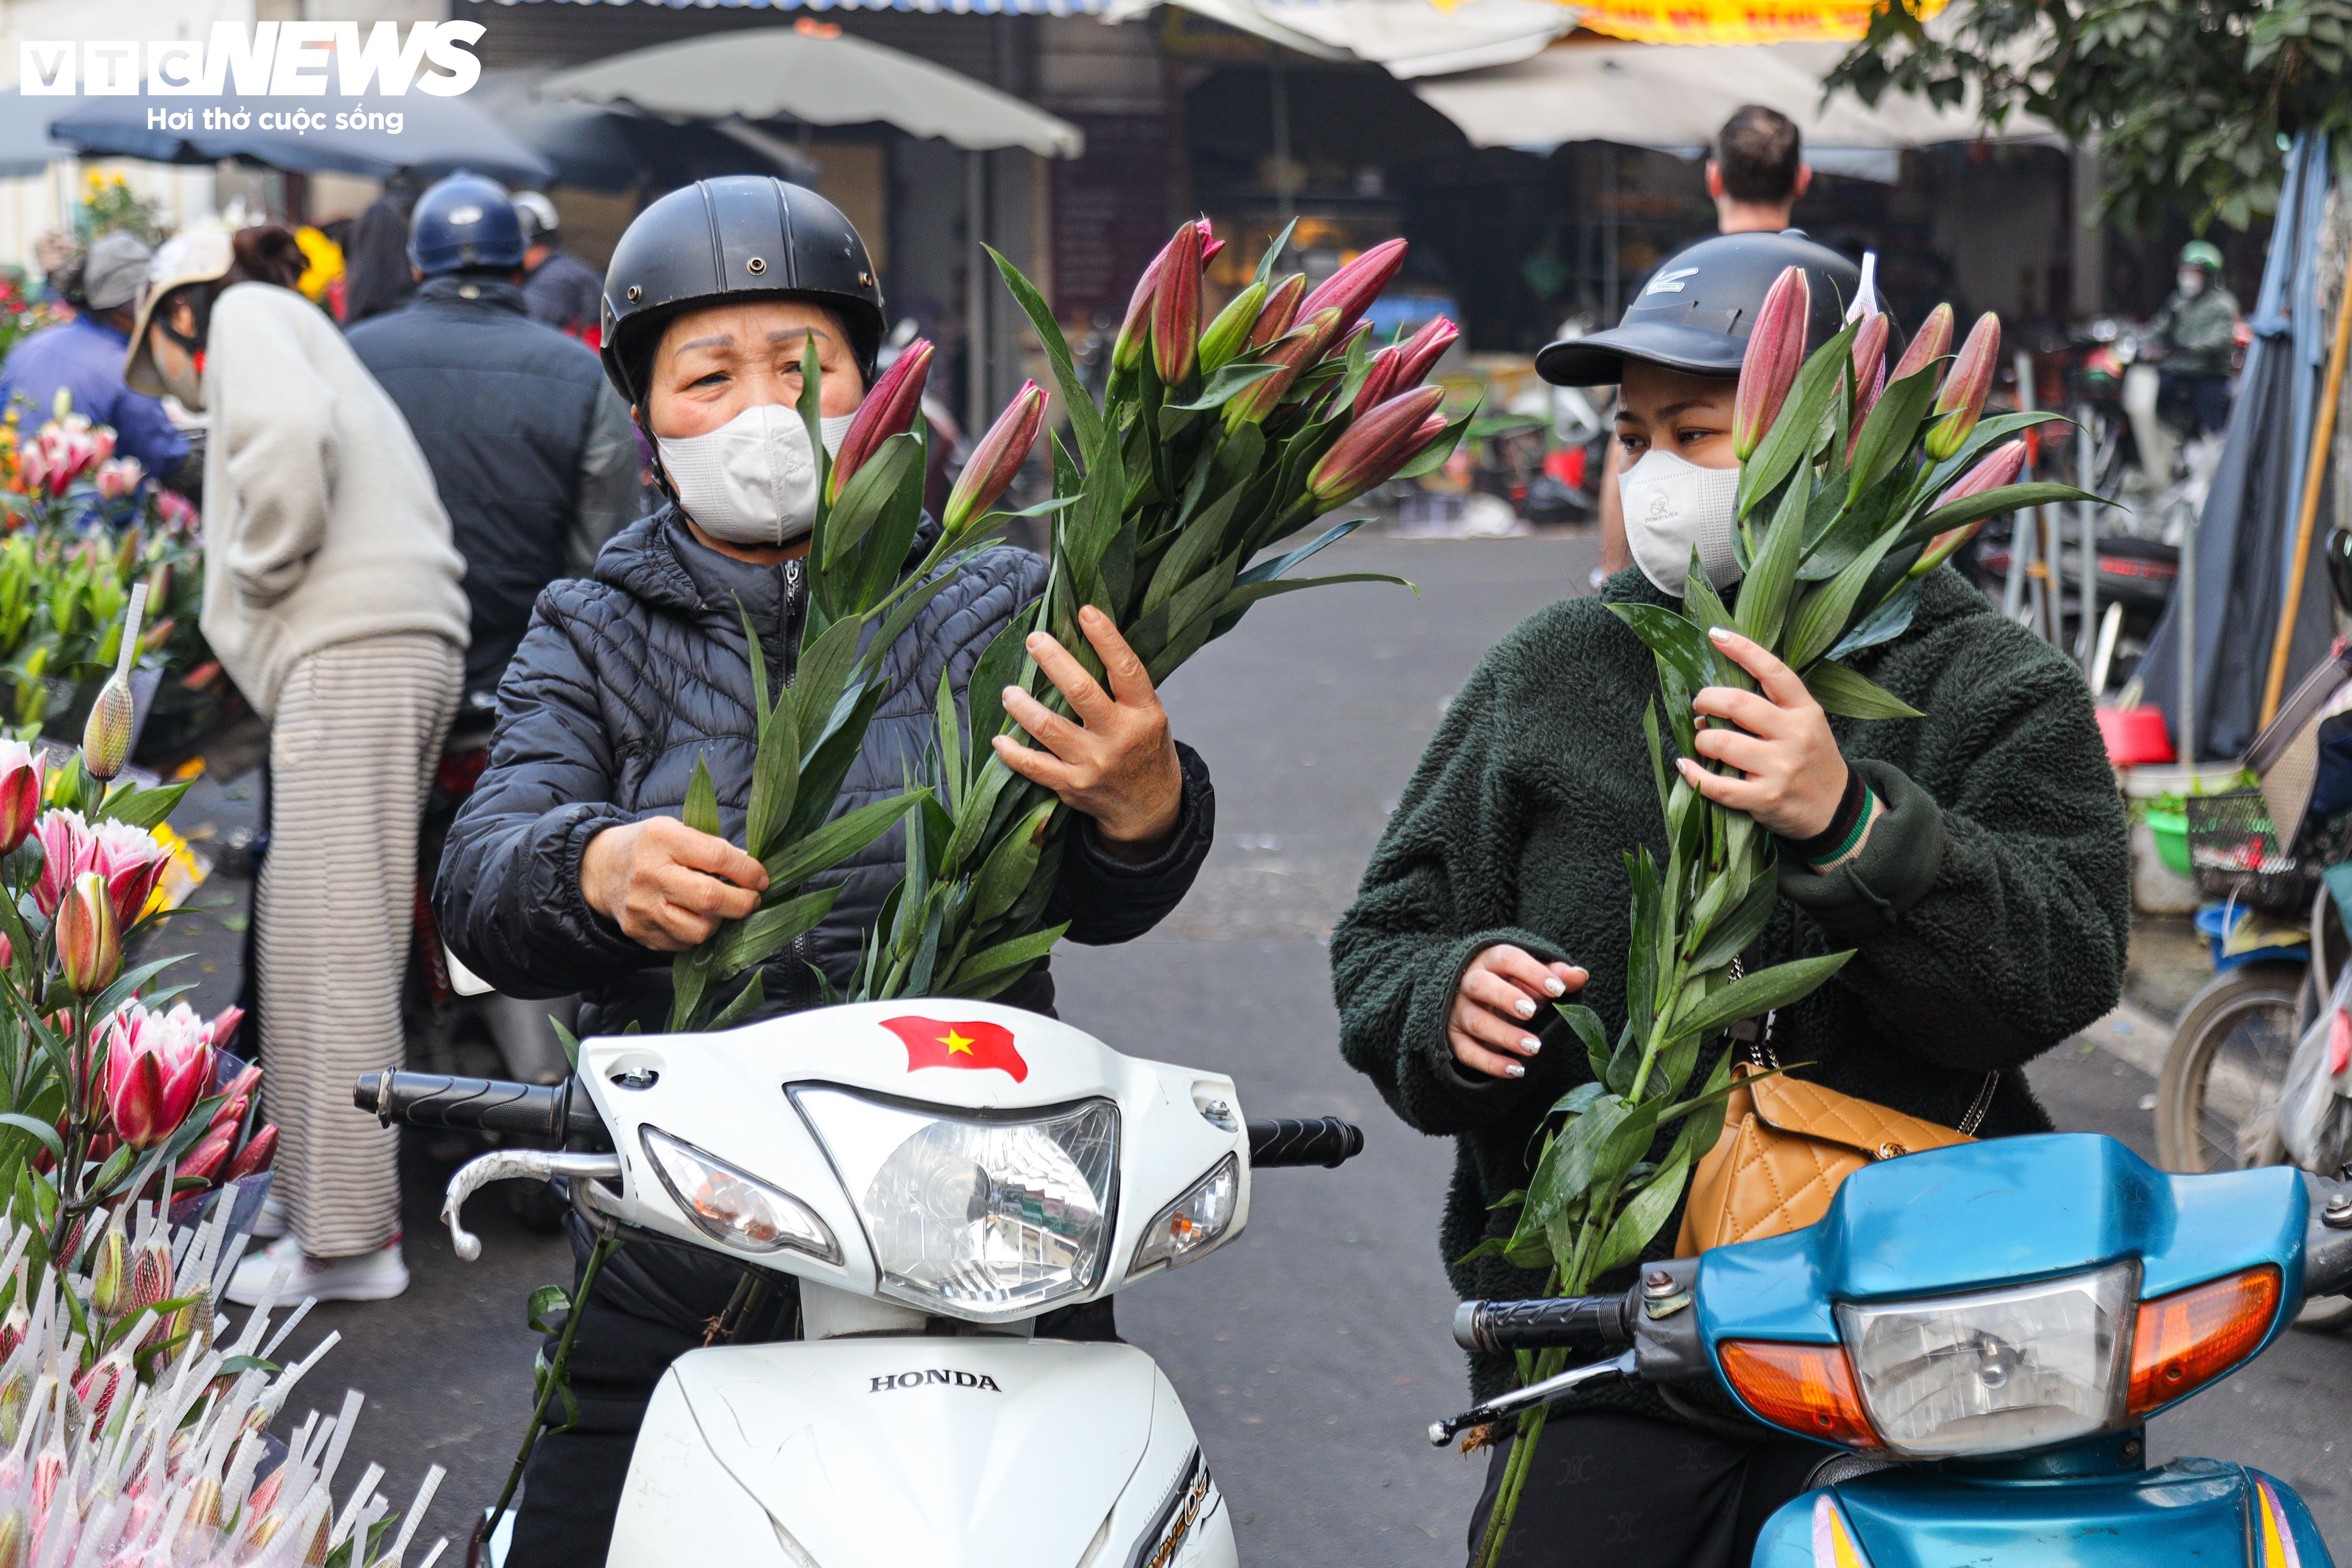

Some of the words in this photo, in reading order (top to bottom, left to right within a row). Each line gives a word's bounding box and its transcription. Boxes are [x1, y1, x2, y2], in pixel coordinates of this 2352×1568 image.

[869, 1369, 1002, 1393] HONDA
[1144, 1505, 1156, 1525] CITY
[1157, 1473, 1177, 1505] FASHION
